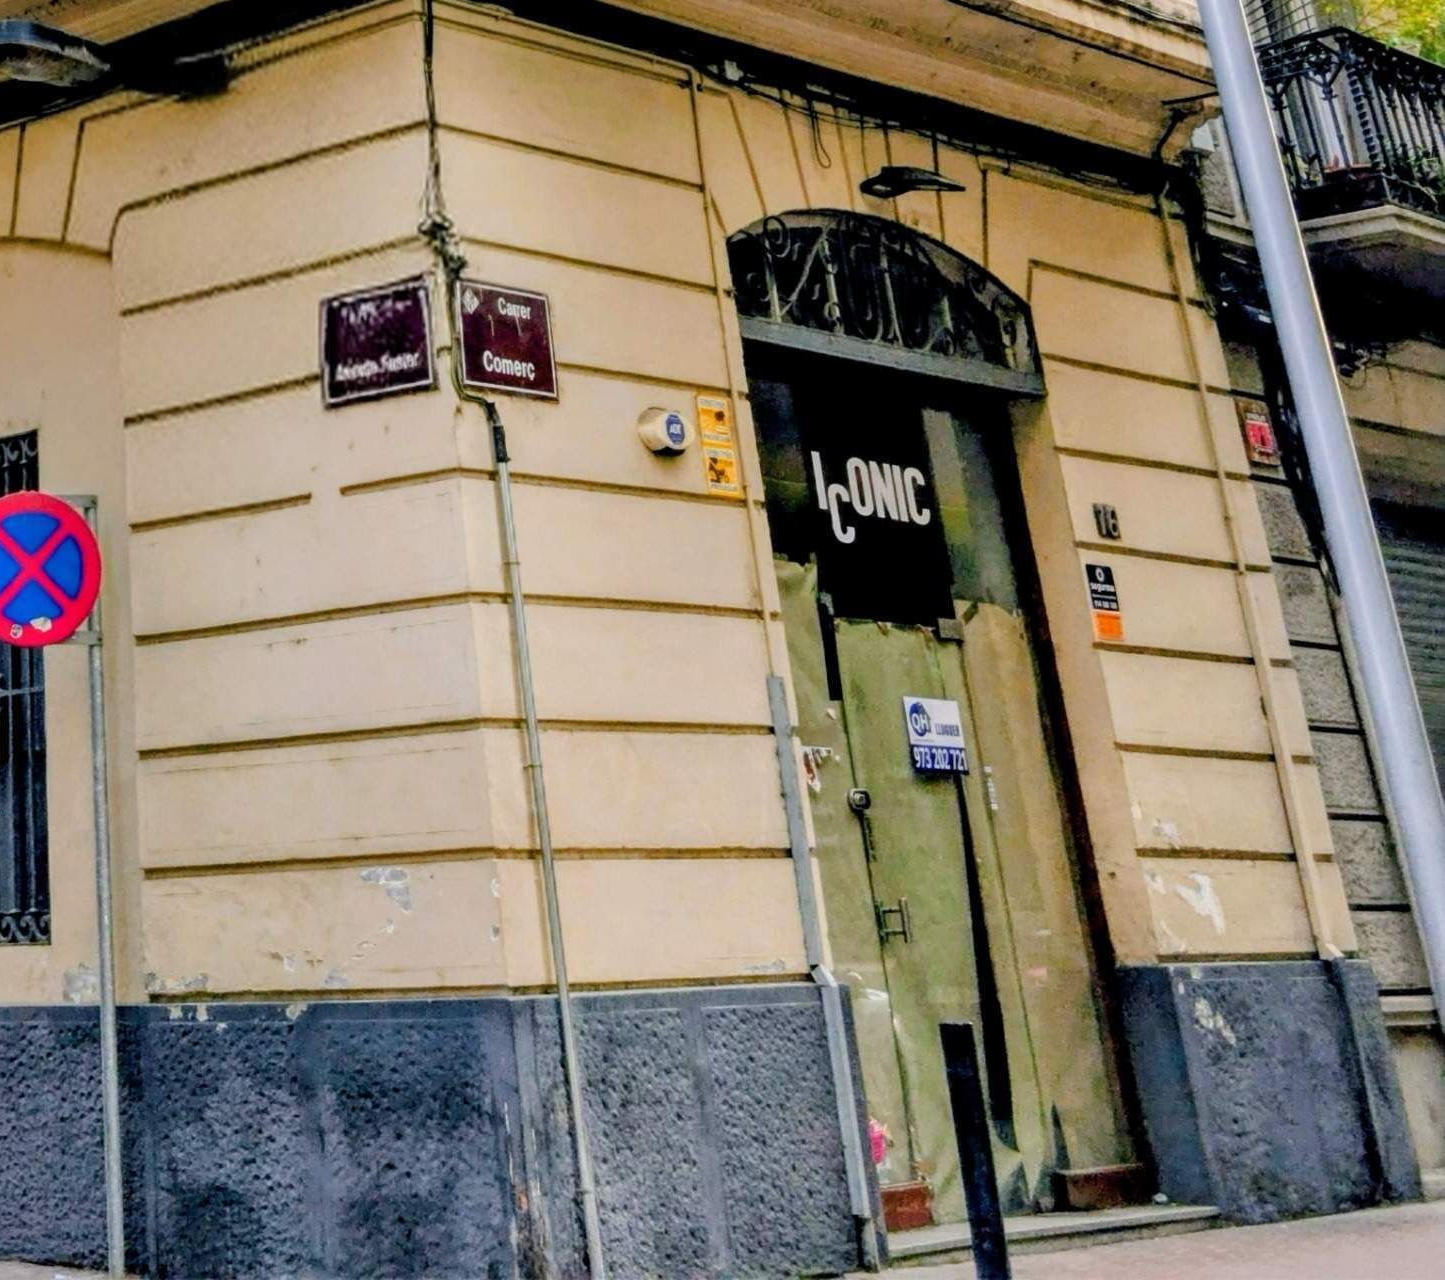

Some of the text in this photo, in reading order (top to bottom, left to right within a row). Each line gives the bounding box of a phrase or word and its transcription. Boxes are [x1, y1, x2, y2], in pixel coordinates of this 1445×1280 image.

[497, 297, 531, 319] Carrer
[482, 350, 535, 381] Comerç
[811, 450, 931, 544] ICONIC
[913, 746, 932, 769] 973
[931, 748, 951, 770] 202
